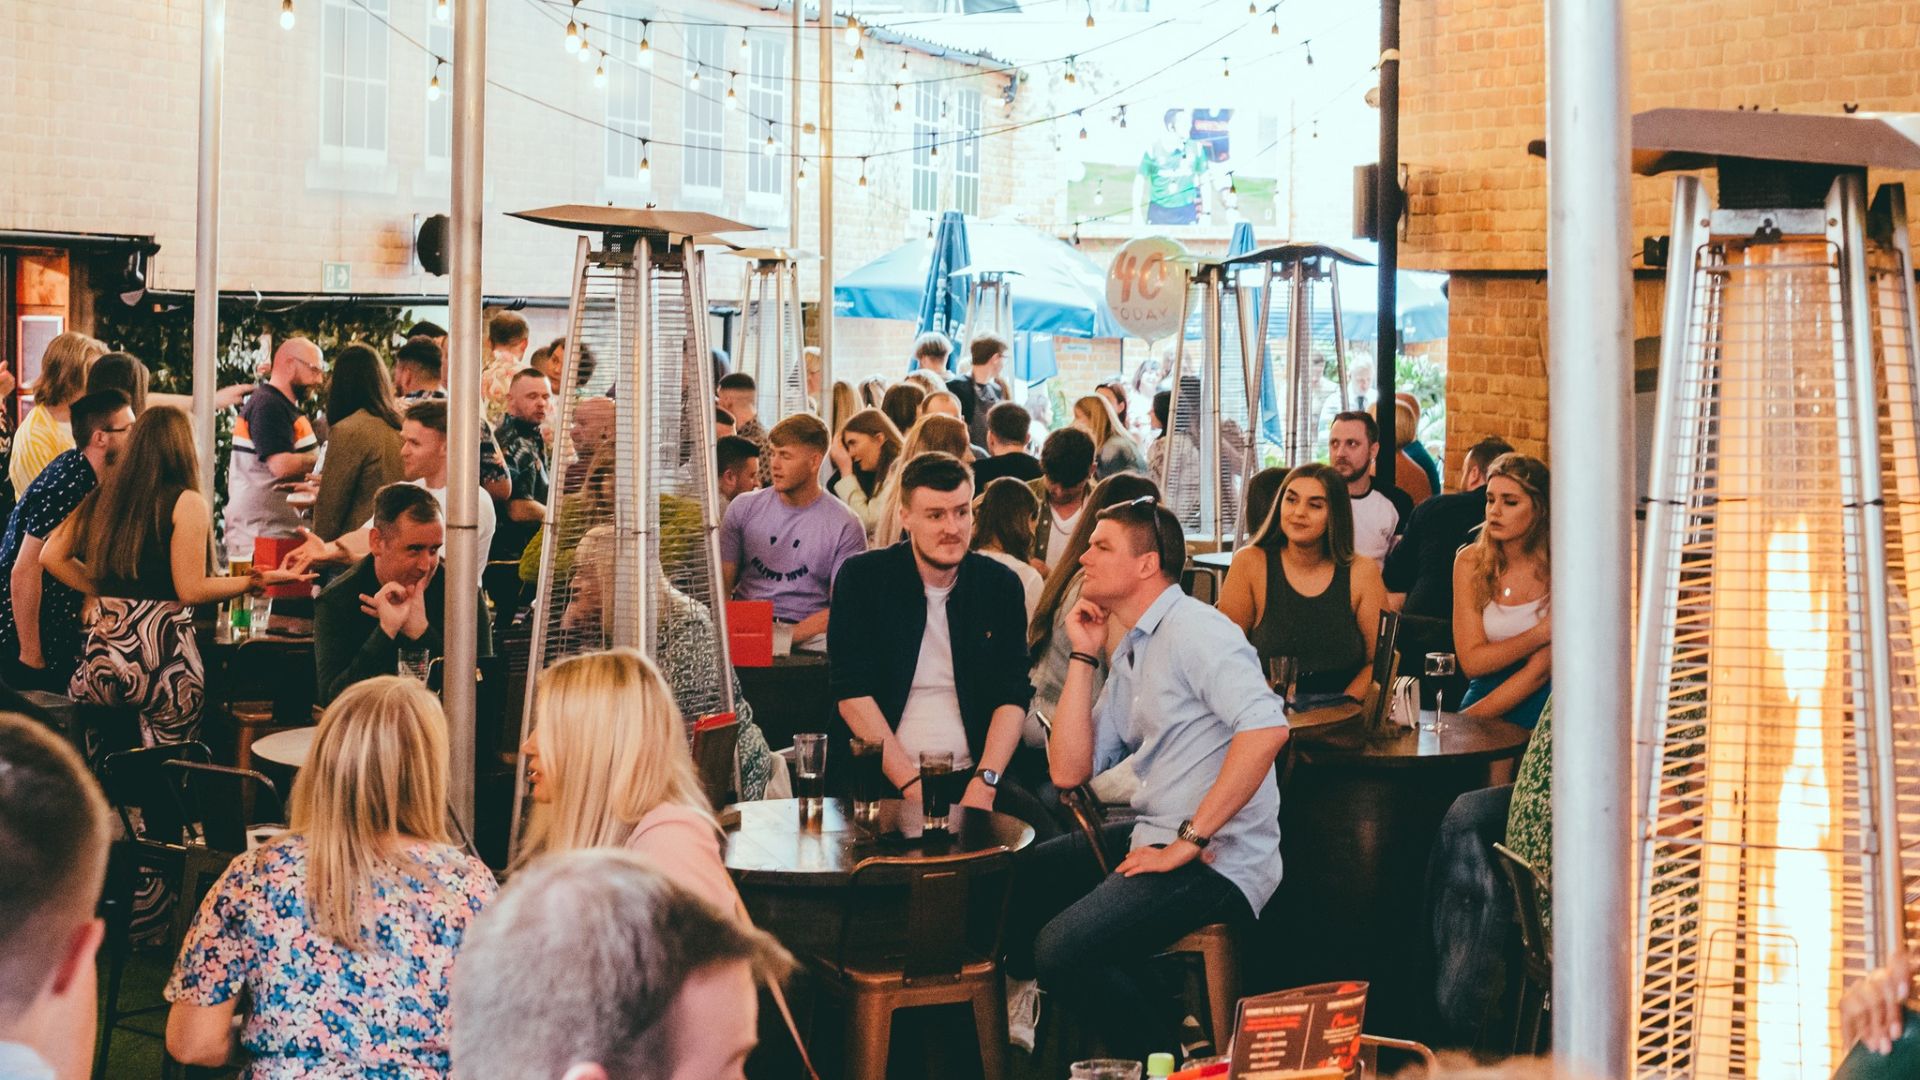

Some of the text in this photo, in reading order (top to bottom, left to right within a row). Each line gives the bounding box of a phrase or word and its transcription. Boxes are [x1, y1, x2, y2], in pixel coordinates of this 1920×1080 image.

[1115, 251, 1168, 303] 40
[1111, 306, 1168, 320] TODAY
[785, 565, 809, 582] PAUL
